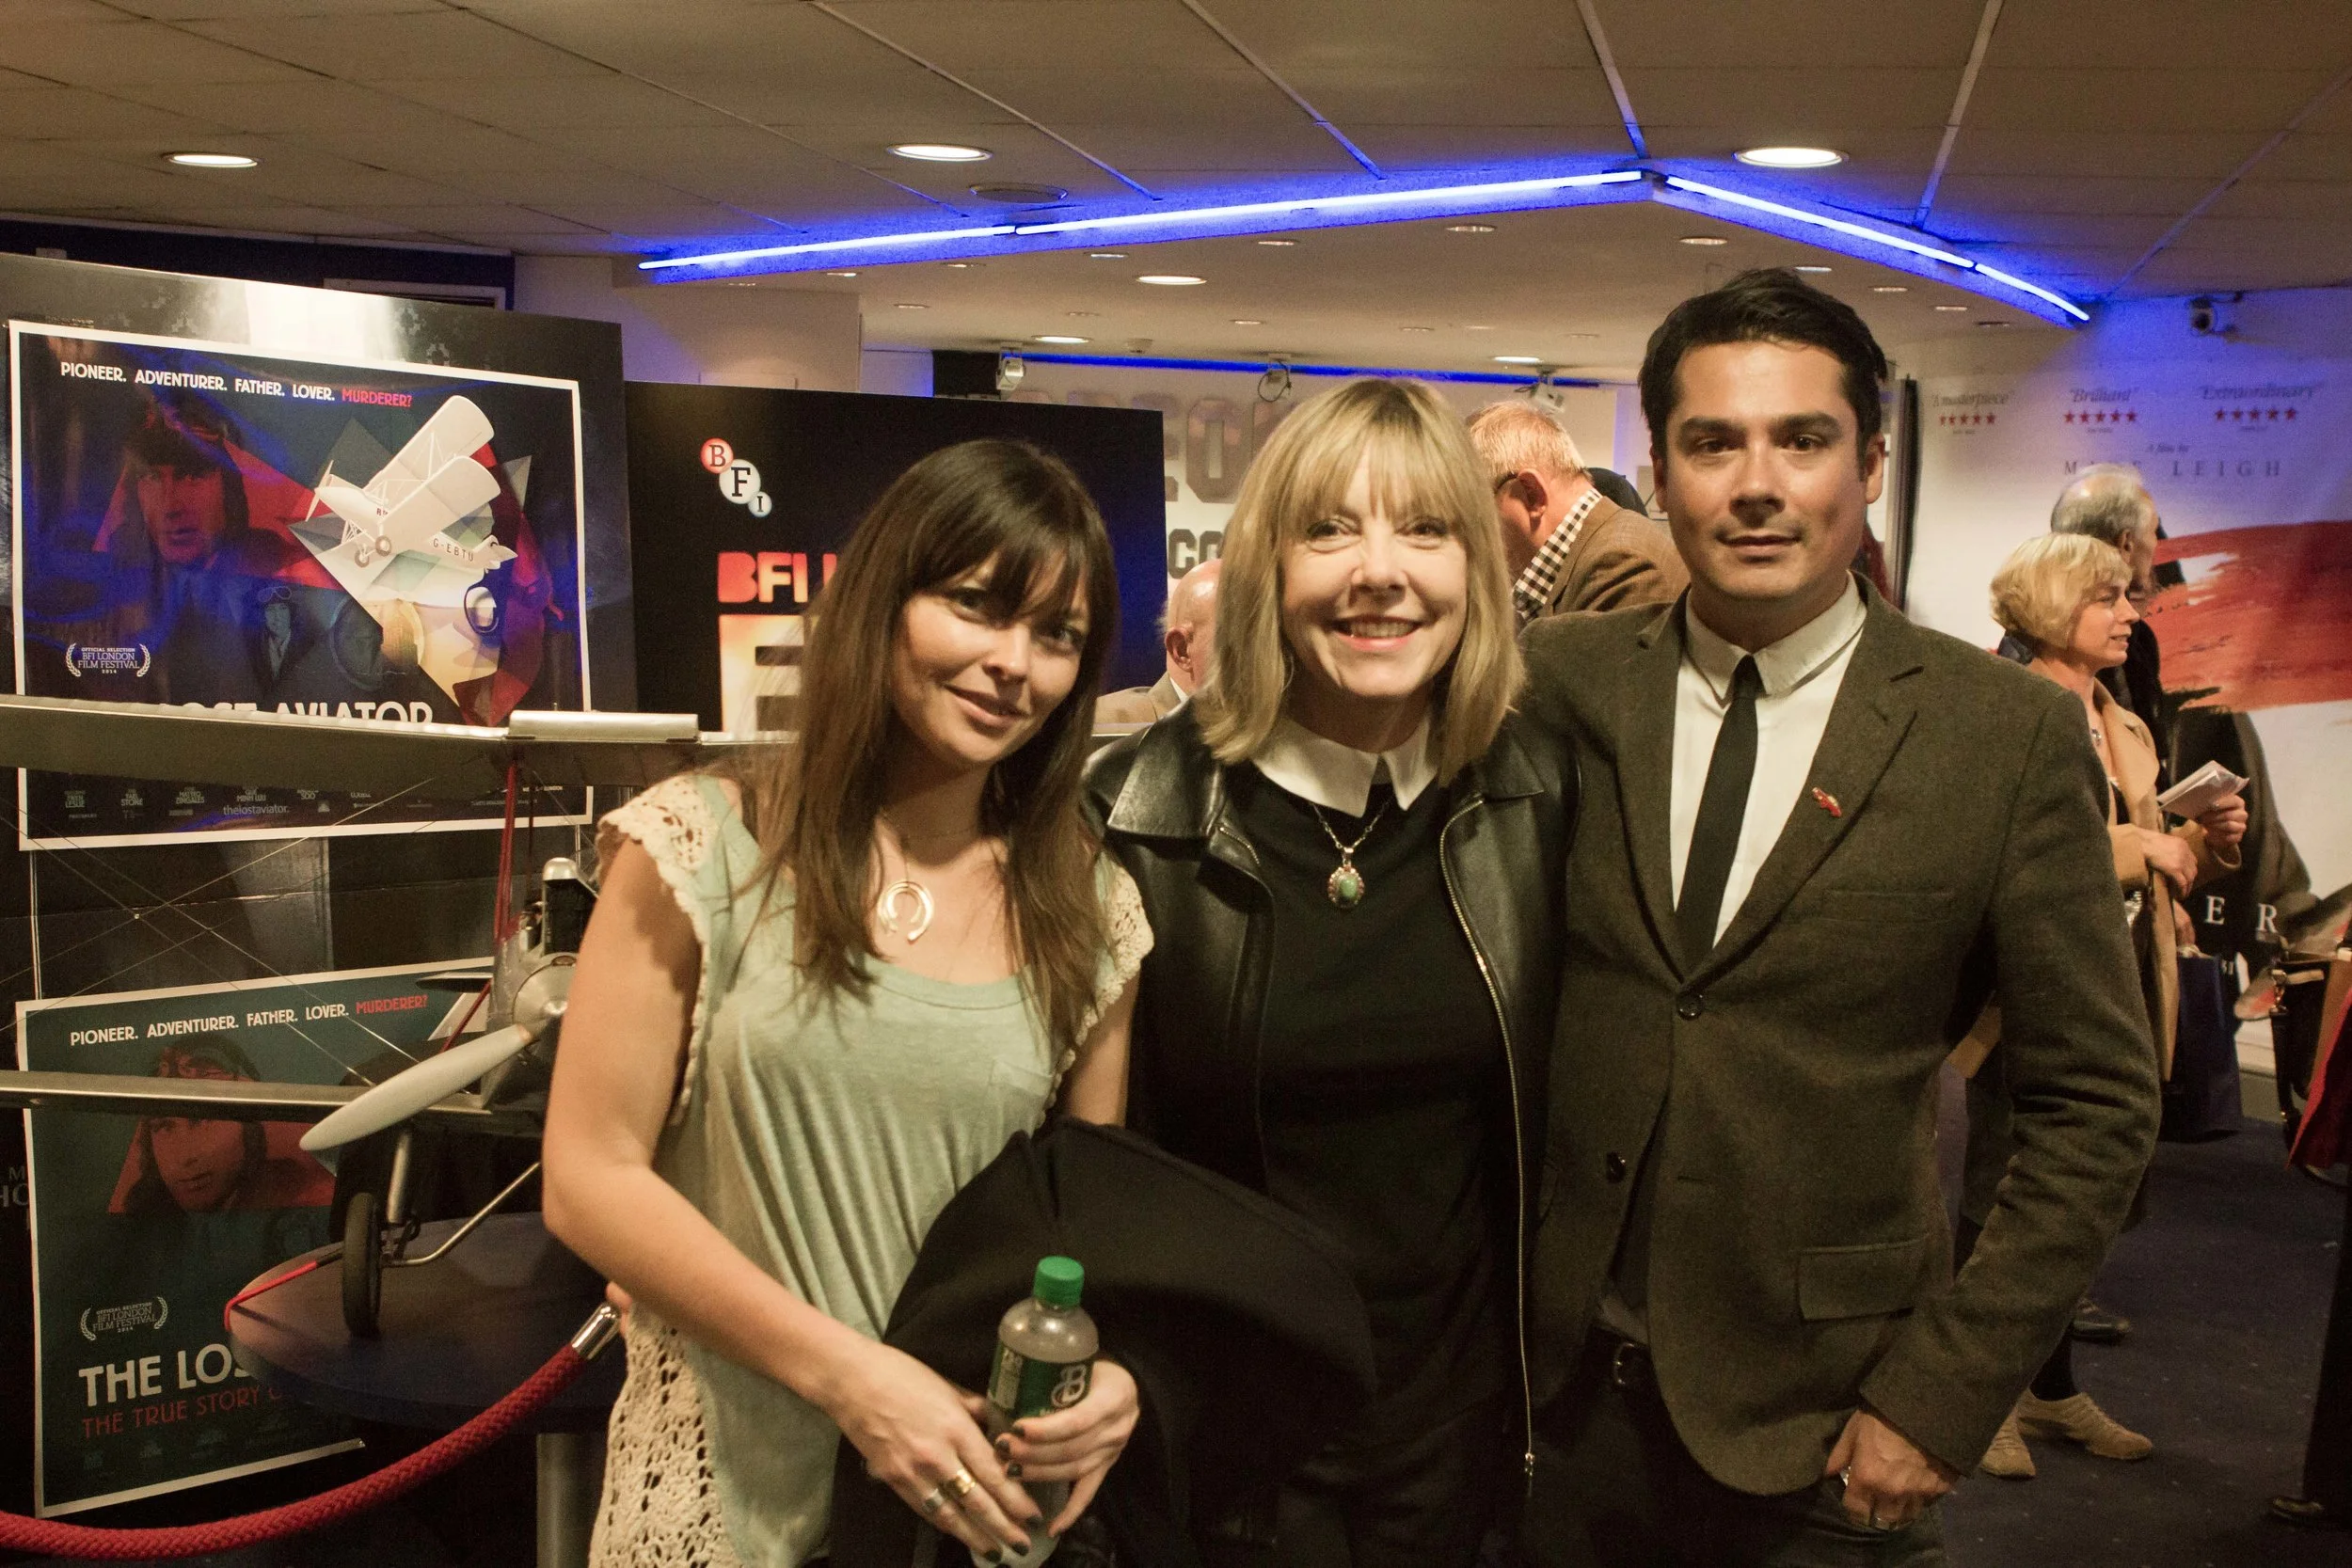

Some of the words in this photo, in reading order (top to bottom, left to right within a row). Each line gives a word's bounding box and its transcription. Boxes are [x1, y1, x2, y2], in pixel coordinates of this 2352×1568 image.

[60, 361, 127, 382] PIONEER.
[135, 370, 228, 391] ADVENTURER.
[234, 378, 285, 396] FATHER.
[292, 384, 335, 401] LOVER.
[342, 388, 413, 407] MURDERER?
[708, 444, 764, 513] BFI
[433, 537, 474, 562] G-EBTU
[718, 551, 809, 604] BFI
[77, 660, 98, 669] FILM
[101, 660, 140, 669] FESTIVAL
[71, 1025, 138, 1047] PIONEER.
[147, 1015, 240, 1038] ADVENTURER.
[246, 1008, 298, 1027] FATHER.
[306, 1003, 349, 1021] LOVER.
[356, 994, 428, 1015] MURDERER?
[92, 1321, 114, 1332] FILM
[117, 1314, 157, 1327] FESTIVAL
[113, 1307, 151, 1320] LONDON
[78, 1355, 162, 1407] THE
[177, 1343, 249, 1389] LO
[83, 1412, 124, 1438] THE
[134, 1400, 188, 1428] TRUE
[197, 1385, 260, 1417] STORY
